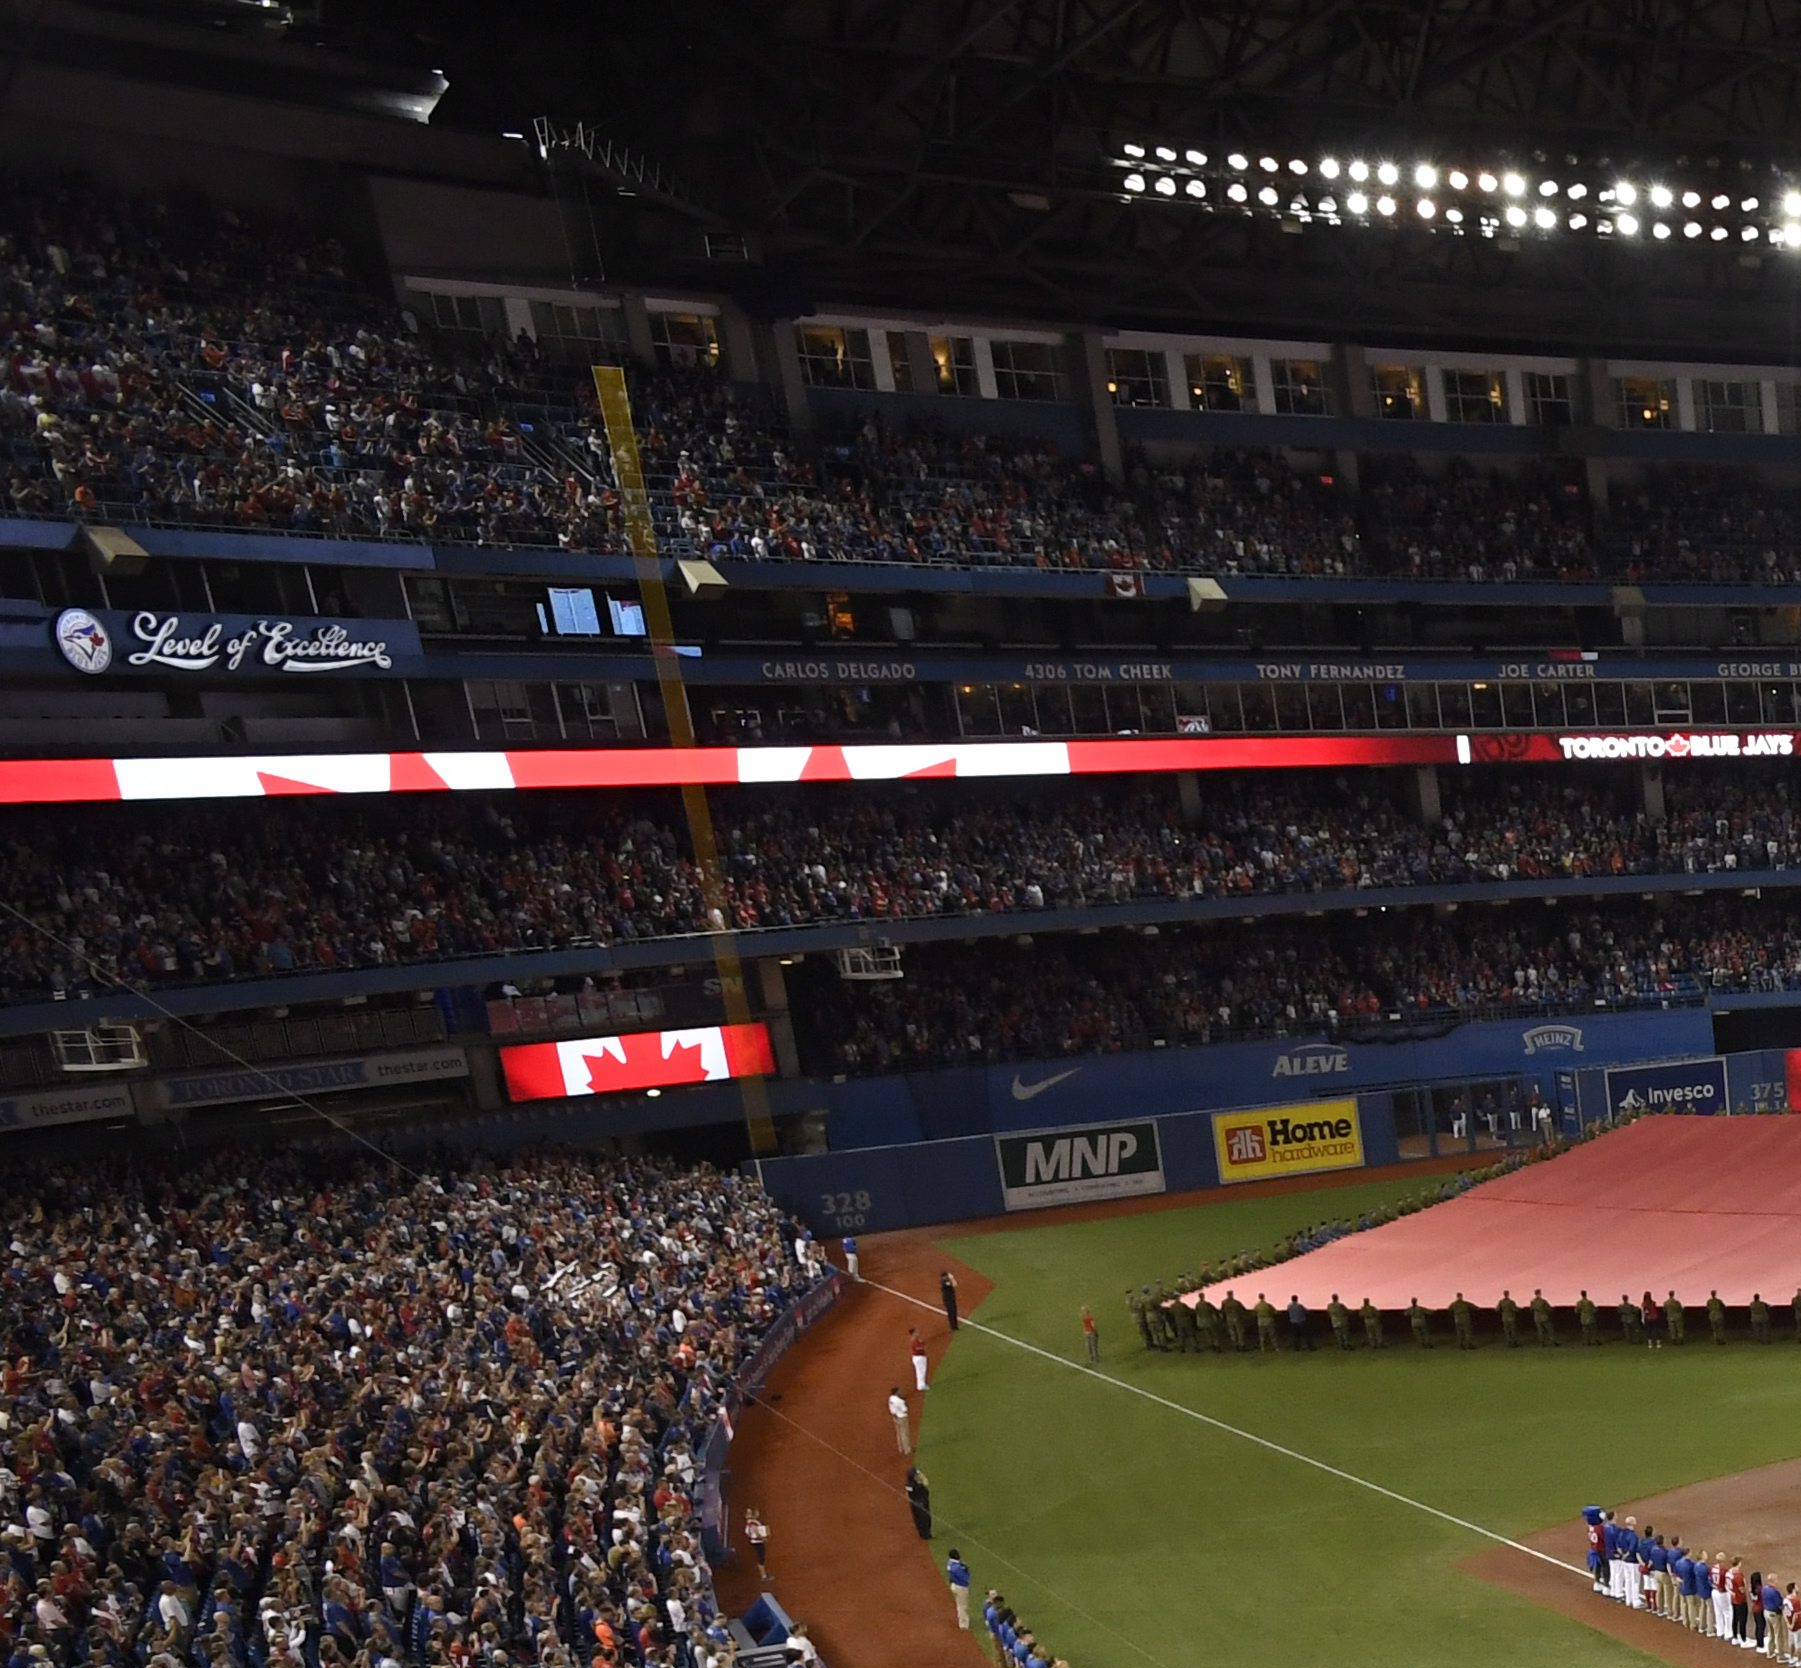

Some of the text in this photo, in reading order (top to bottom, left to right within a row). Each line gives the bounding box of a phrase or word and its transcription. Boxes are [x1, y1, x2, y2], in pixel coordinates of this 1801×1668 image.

[129, 611, 222, 671] Level
[228, 630, 258, 671] of
[259, 619, 393, 672] Excellence
[763, 662, 916, 679] CARLOS DELGADO
[1025, 664, 1172, 680] 4306 TOM CHEEK
[1256, 664, 1405, 678] TONY FERNANDEZ
[1499, 663, 1595, 678] JOE CARTER
[1717, 663, 1781, 677] GEORGE
[1559, 734, 1793, 758] TORONTO BLUE JAYS
[1534, 1030, 1572, 1047] HEINZ
[377, 1056, 462, 1078] thestar.com
[1272, 1054, 1348, 1078] ALEVE
[1648, 1082, 1714, 1105] Invesco
[1751, 1081, 1784, 1100] 375
[31, 1096, 125, 1118] thestar.com
[1267, 1117, 1352, 1147] Home
[1025, 1132, 1138, 1184] MNP
[1272, 1140, 1355, 1164] hardware
[820, 1189, 872, 1216] 328
[836, 1213, 866, 1229] 100
